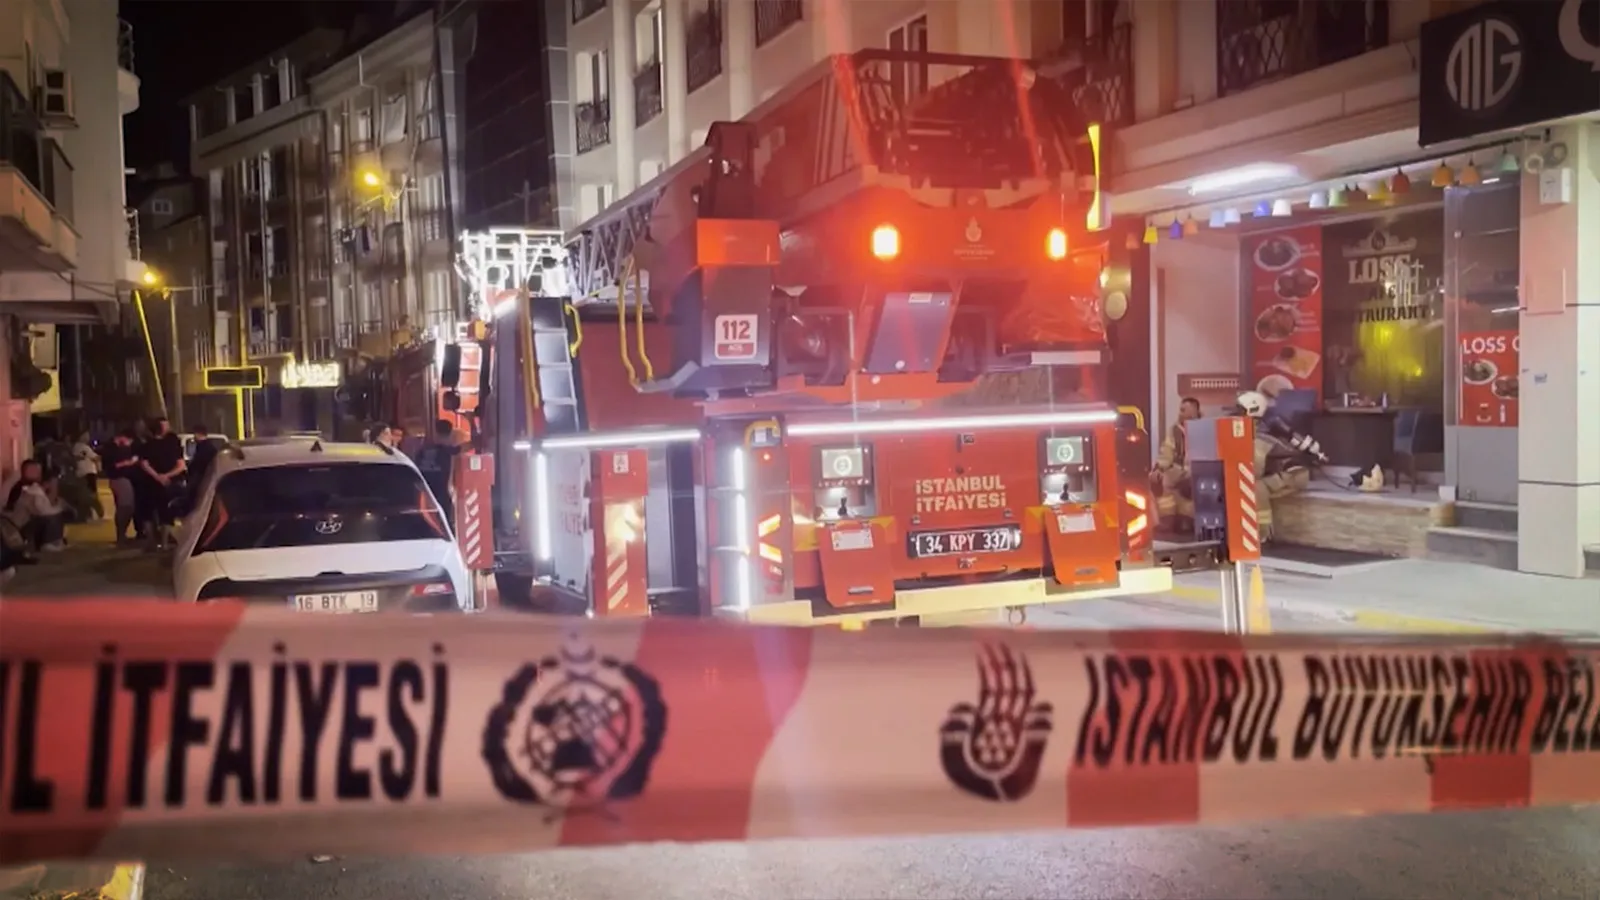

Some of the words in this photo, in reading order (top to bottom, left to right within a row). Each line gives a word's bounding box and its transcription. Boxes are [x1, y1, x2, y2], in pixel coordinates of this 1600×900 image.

[1348, 254, 1411, 284] LOSS
[1354, 305, 1427, 323] TAURANT
[722, 320, 751, 340] 112
[1463, 336, 1506, 354] LOSS
[916, 475, 1006, 495] İSTANBUL
[916, 492, 1007, 513] İTFAİYESİ
[926, 536, 943, 553] 34
[949, 533, 975, 551] KPY
[982, 531, 1008, 549] 337
[299, 596, 314, 610] 16
[321, 592, 348, 609] BTK
[0, 660, 55, 813] L
[85, 642, 449, 812] İTFAİYESİ
